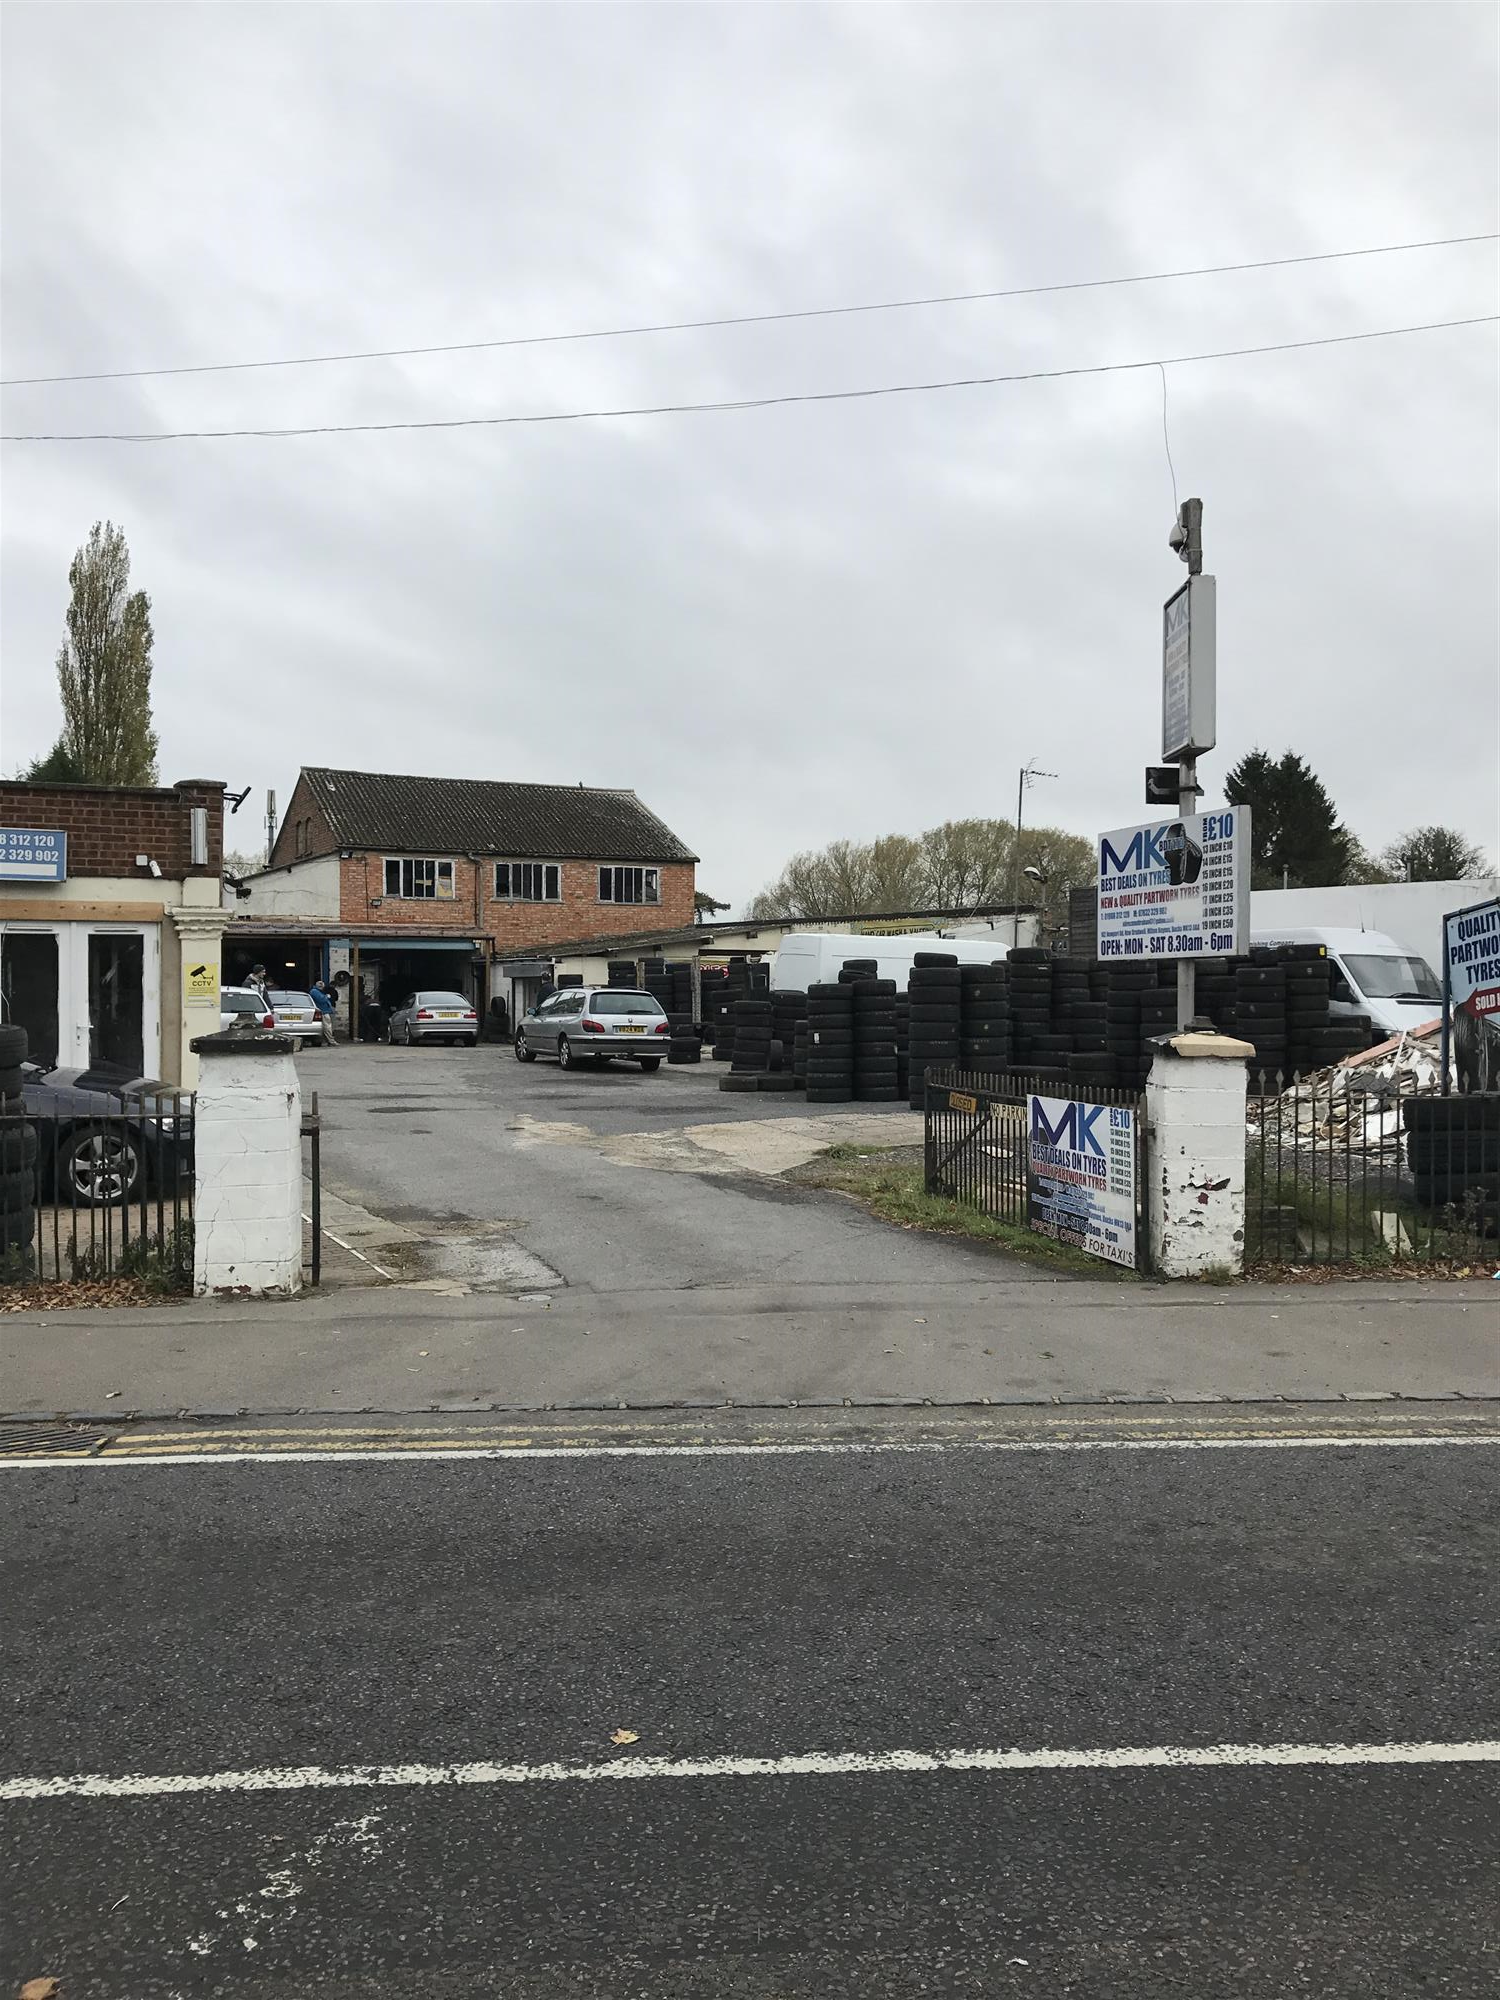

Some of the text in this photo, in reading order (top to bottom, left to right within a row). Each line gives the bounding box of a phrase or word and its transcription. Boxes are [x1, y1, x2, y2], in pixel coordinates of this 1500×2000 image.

[1208, 813, 1233, 841] £10
[10, 834, 31, 846] 312
[34, 835, 55, 847] 120
[1202, 840, 1233, 854] 13 INCH £10
[9, 849, 33, 861] 329
[35, 850, 59, 862] 902
[1101, 826, 1170, 875] MK
[1202, 853, 1233, 867] 14 INCH £15
[1101, 869, 1171, 892] BEST DEALS ON TYRES
[1202, 866, 1233, 880] 15 INCH £15
[1202, 879, 1233, 892] 16 INCH £20
[1101, 896, 1113, 909] NEW
[1114, 897, 1118, 907] &
[1119, 893, 1143, 908] QUALITY
[1143, 888, 1179, 905] PARTWORN
[1209, 893, 1222, 904] INCH
[1223, 892, 1233, 903] £25
[1209, 906, 1222, 917] INCH
[1223, 905, 1233, 916] £35
[1202, 918, 1233, 930] 19 INCH £50
[1101, 939, 1123, 956] OPEN:
[1124, 937, 1144, 955] MON
[1150, 936, 1166, 954] SAT
[1167, 934, 1203, 953] 8.30am
[1210, 932, 1233, 951] 6pm
[1450, 933, 1500, 966] PARTWO
[1475, 994, 1496, 1011] SOLD
[990, 1103, 1028, 1121] NO PARKIN
[1113, 1108, 1130, 1129] £10
[1032, 1096, 1106, 1157] MK
[1032, 1143, 1107, 1178] BEST DEALS ON TYRES
[1054, 1165, 1087, 1187] PARTWORN
[1087, 1175, 1107, 1192] TYRES
[1105, 1228, 1118, 1243] 6pm
[1088, 1239, 1105, 1256] FOR
[1107, 1245, 1133, 1264] TAXI'S
